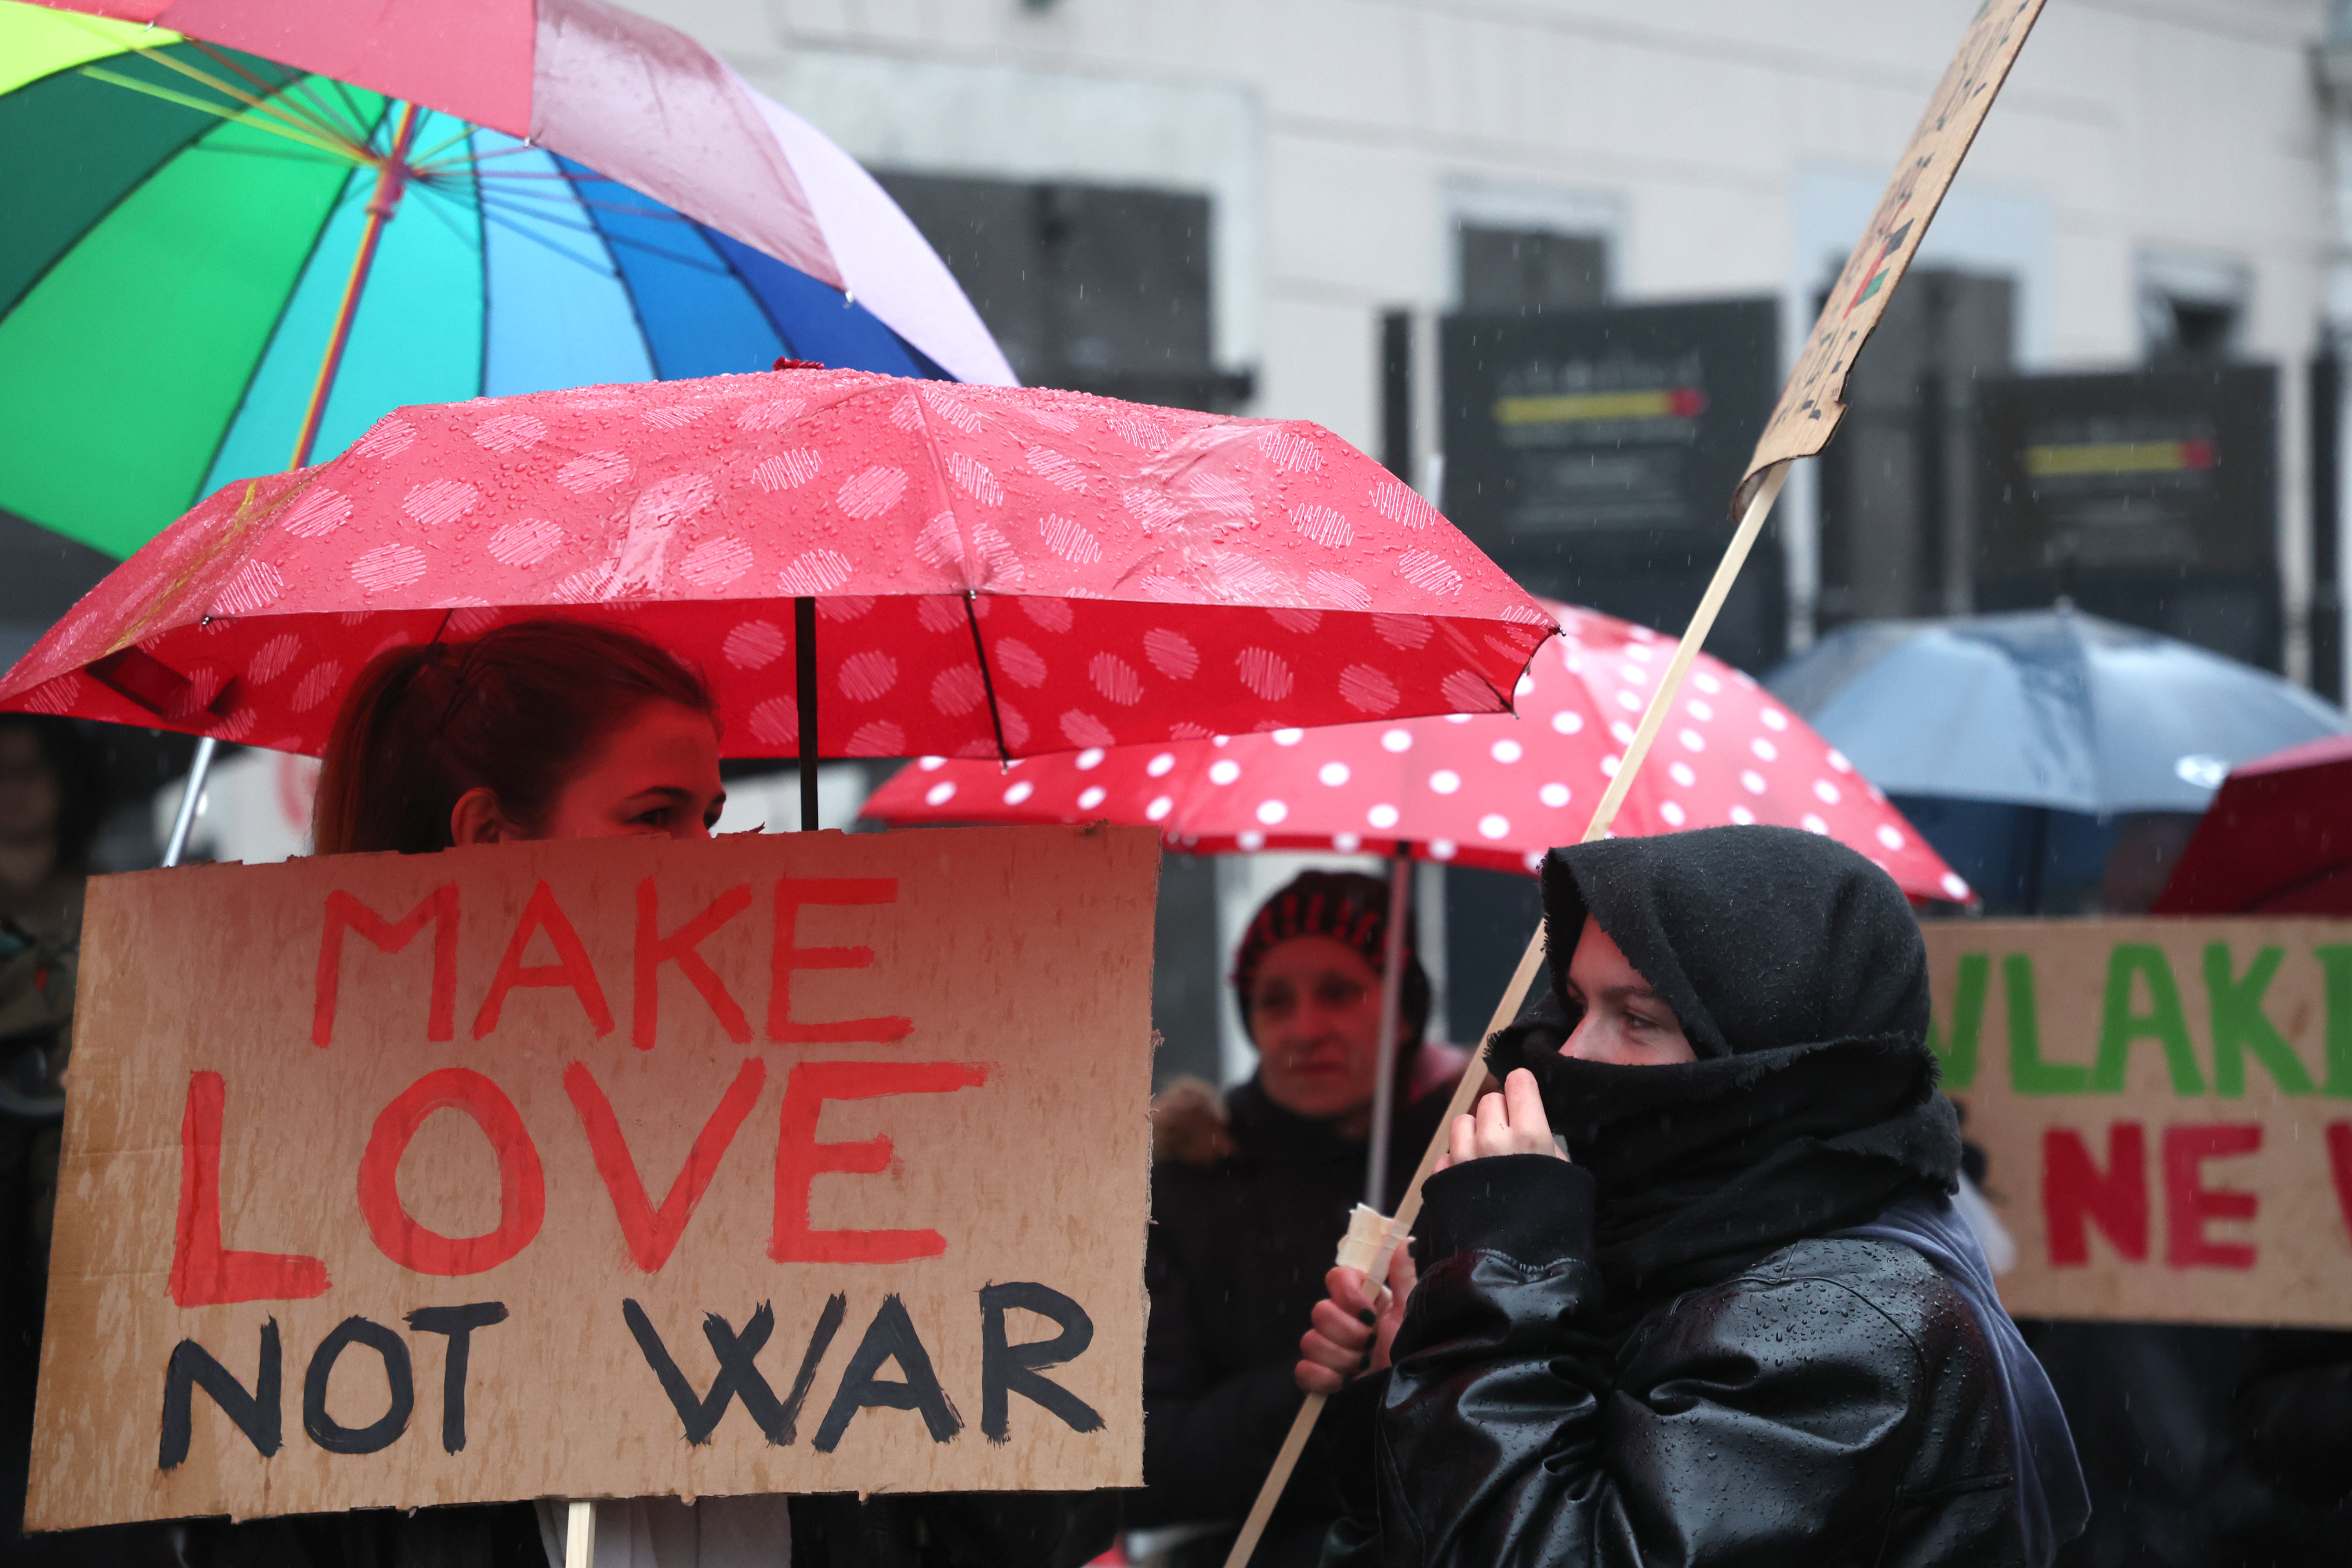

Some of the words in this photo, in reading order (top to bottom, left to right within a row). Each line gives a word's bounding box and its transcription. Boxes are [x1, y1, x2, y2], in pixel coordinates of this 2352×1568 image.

[311, 878, 916, 1051] MAKE
[167, 1056, 996, 1309] LOVE
[2040, 1120, 2263, 1271] NE
[158, 1301, 510, 1473] NOT
[622, 1280, 1107, 1454] WAR
